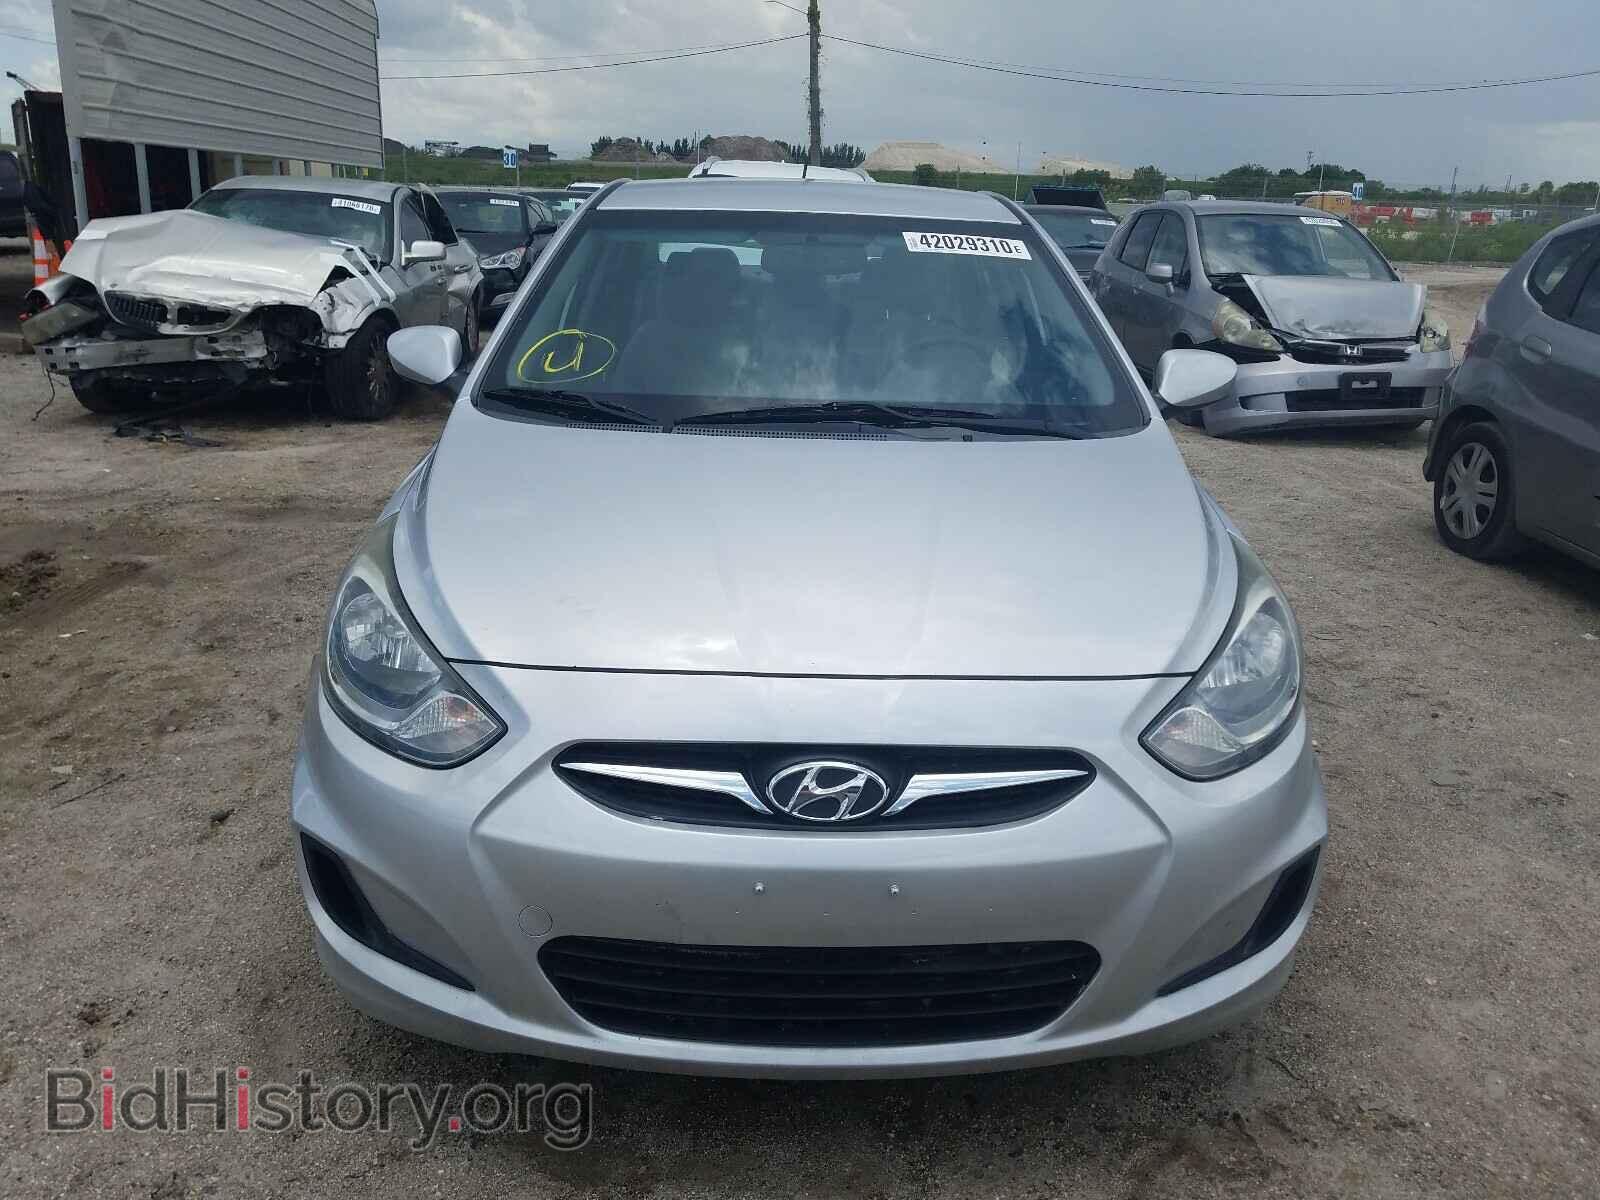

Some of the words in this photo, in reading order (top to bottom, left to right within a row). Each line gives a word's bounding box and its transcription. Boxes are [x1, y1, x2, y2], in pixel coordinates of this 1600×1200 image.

[503, 151, 517, 167] 30
[1352, 185, 1364, 200] 40
[919, 234, 1013, 254] 42029310
